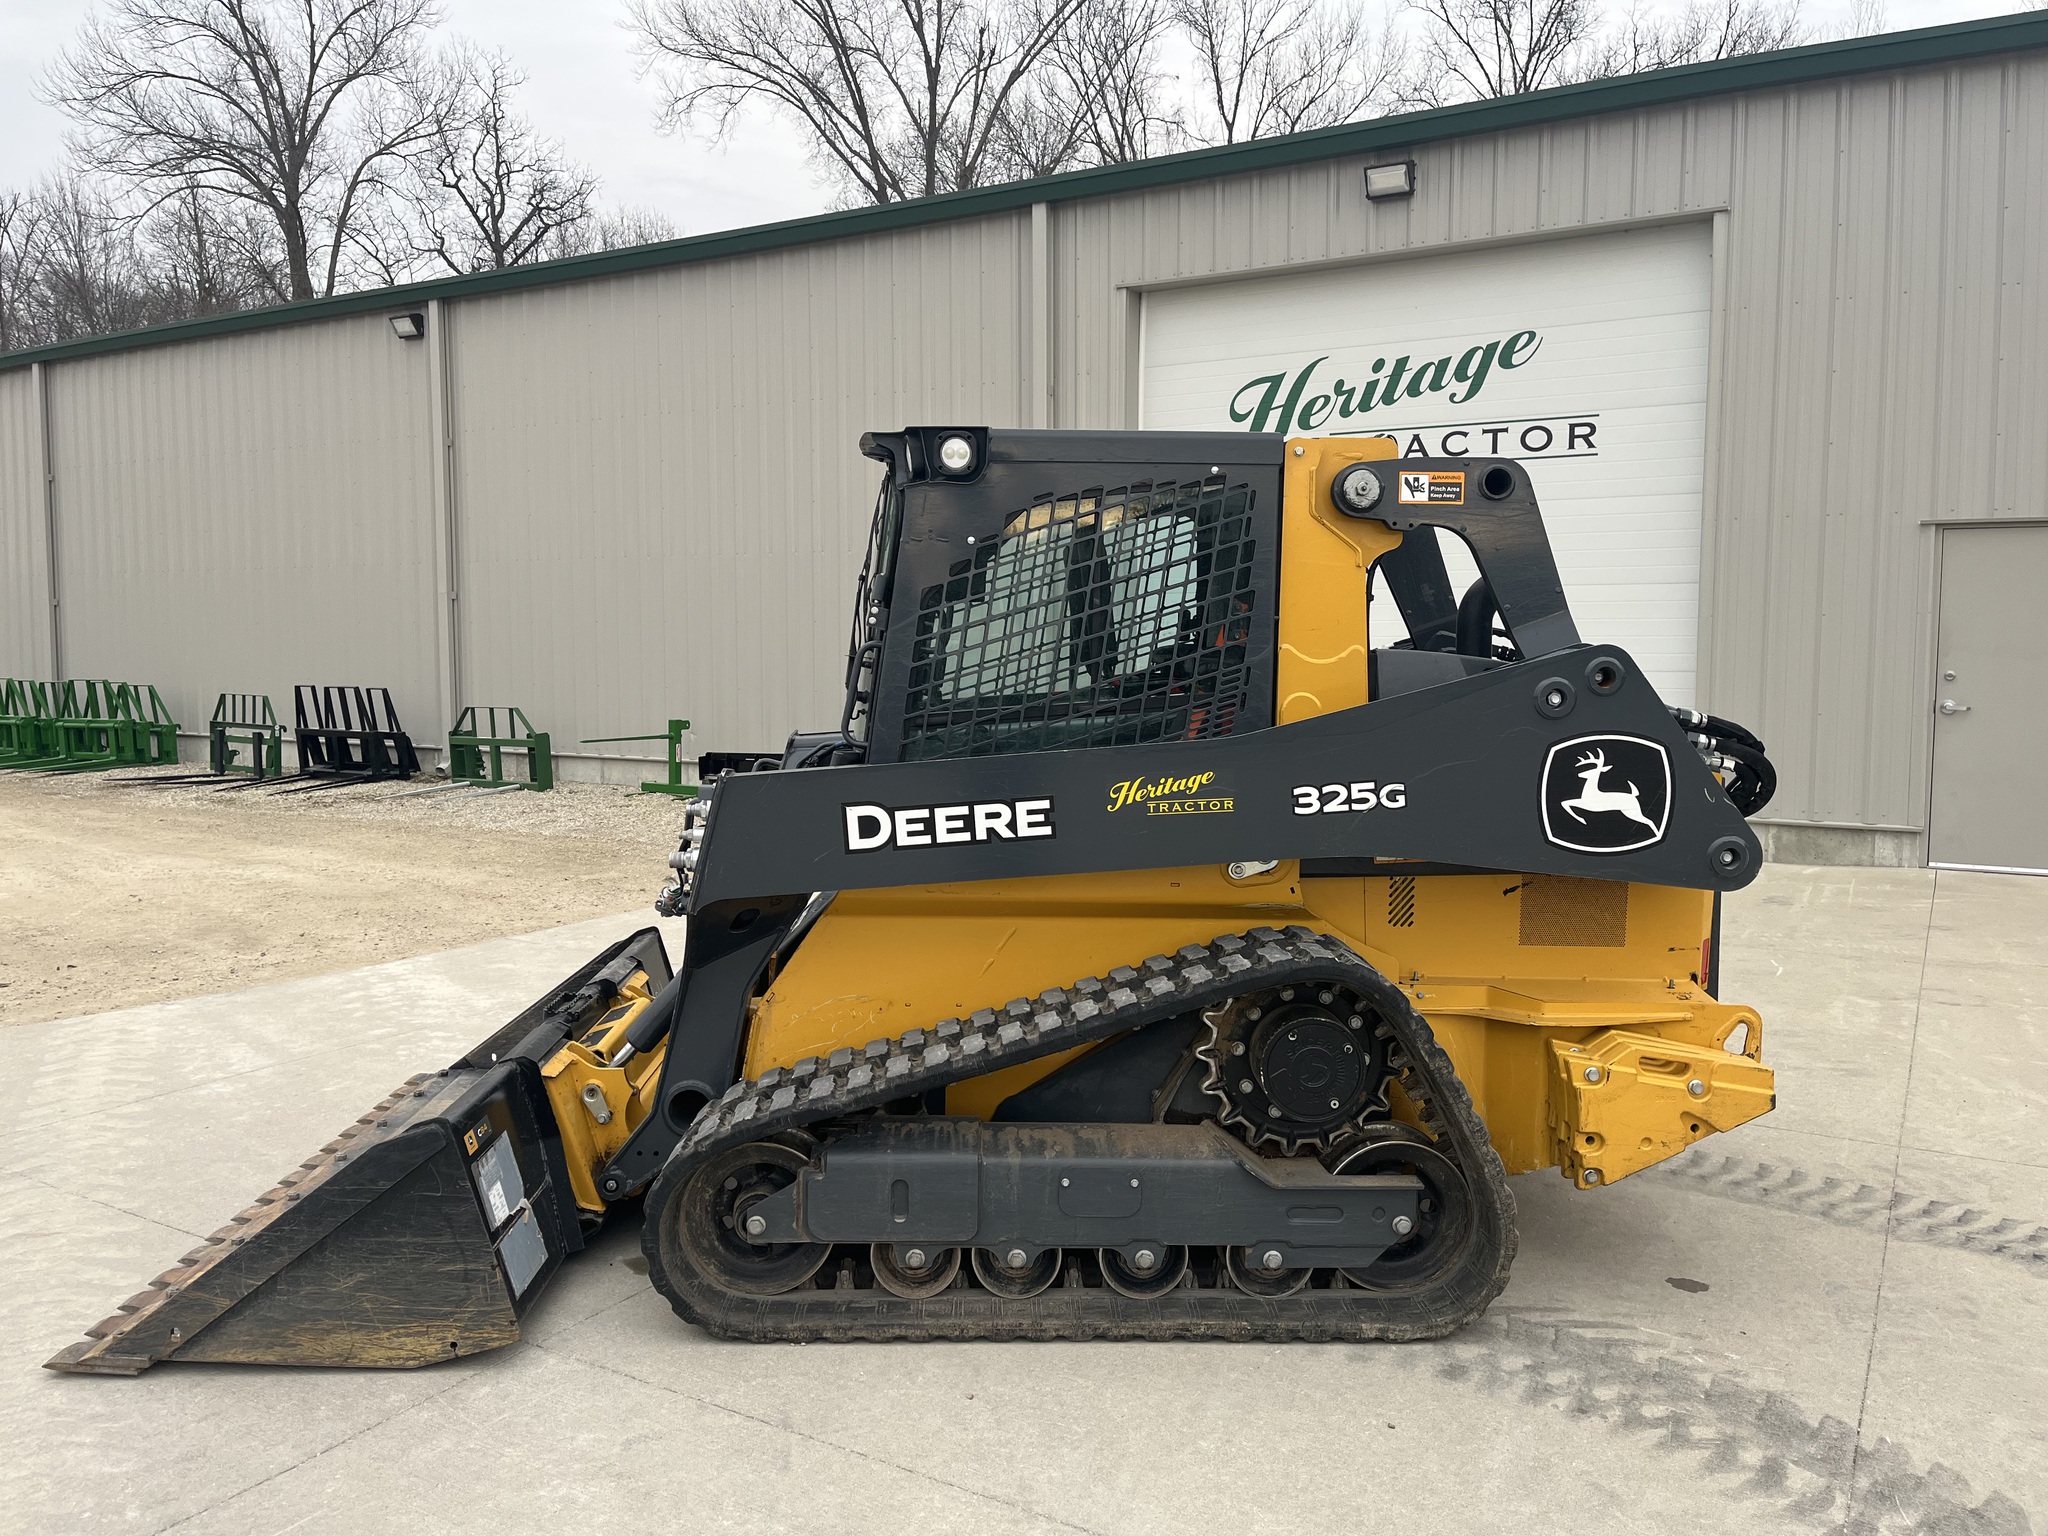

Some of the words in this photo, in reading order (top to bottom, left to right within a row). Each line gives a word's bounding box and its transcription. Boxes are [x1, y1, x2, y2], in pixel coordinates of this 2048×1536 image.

[1229, 330, 1544, 436] Heritage
[1402, 422, 1598, 459] ACTOR
[1107, 771, 1216, 812] Heritage
[1147, 800, 1234, 813] TRACTOR
[1293, 782, 1406, 815] 325G
[845, 799, 1053, 850] DEERE
